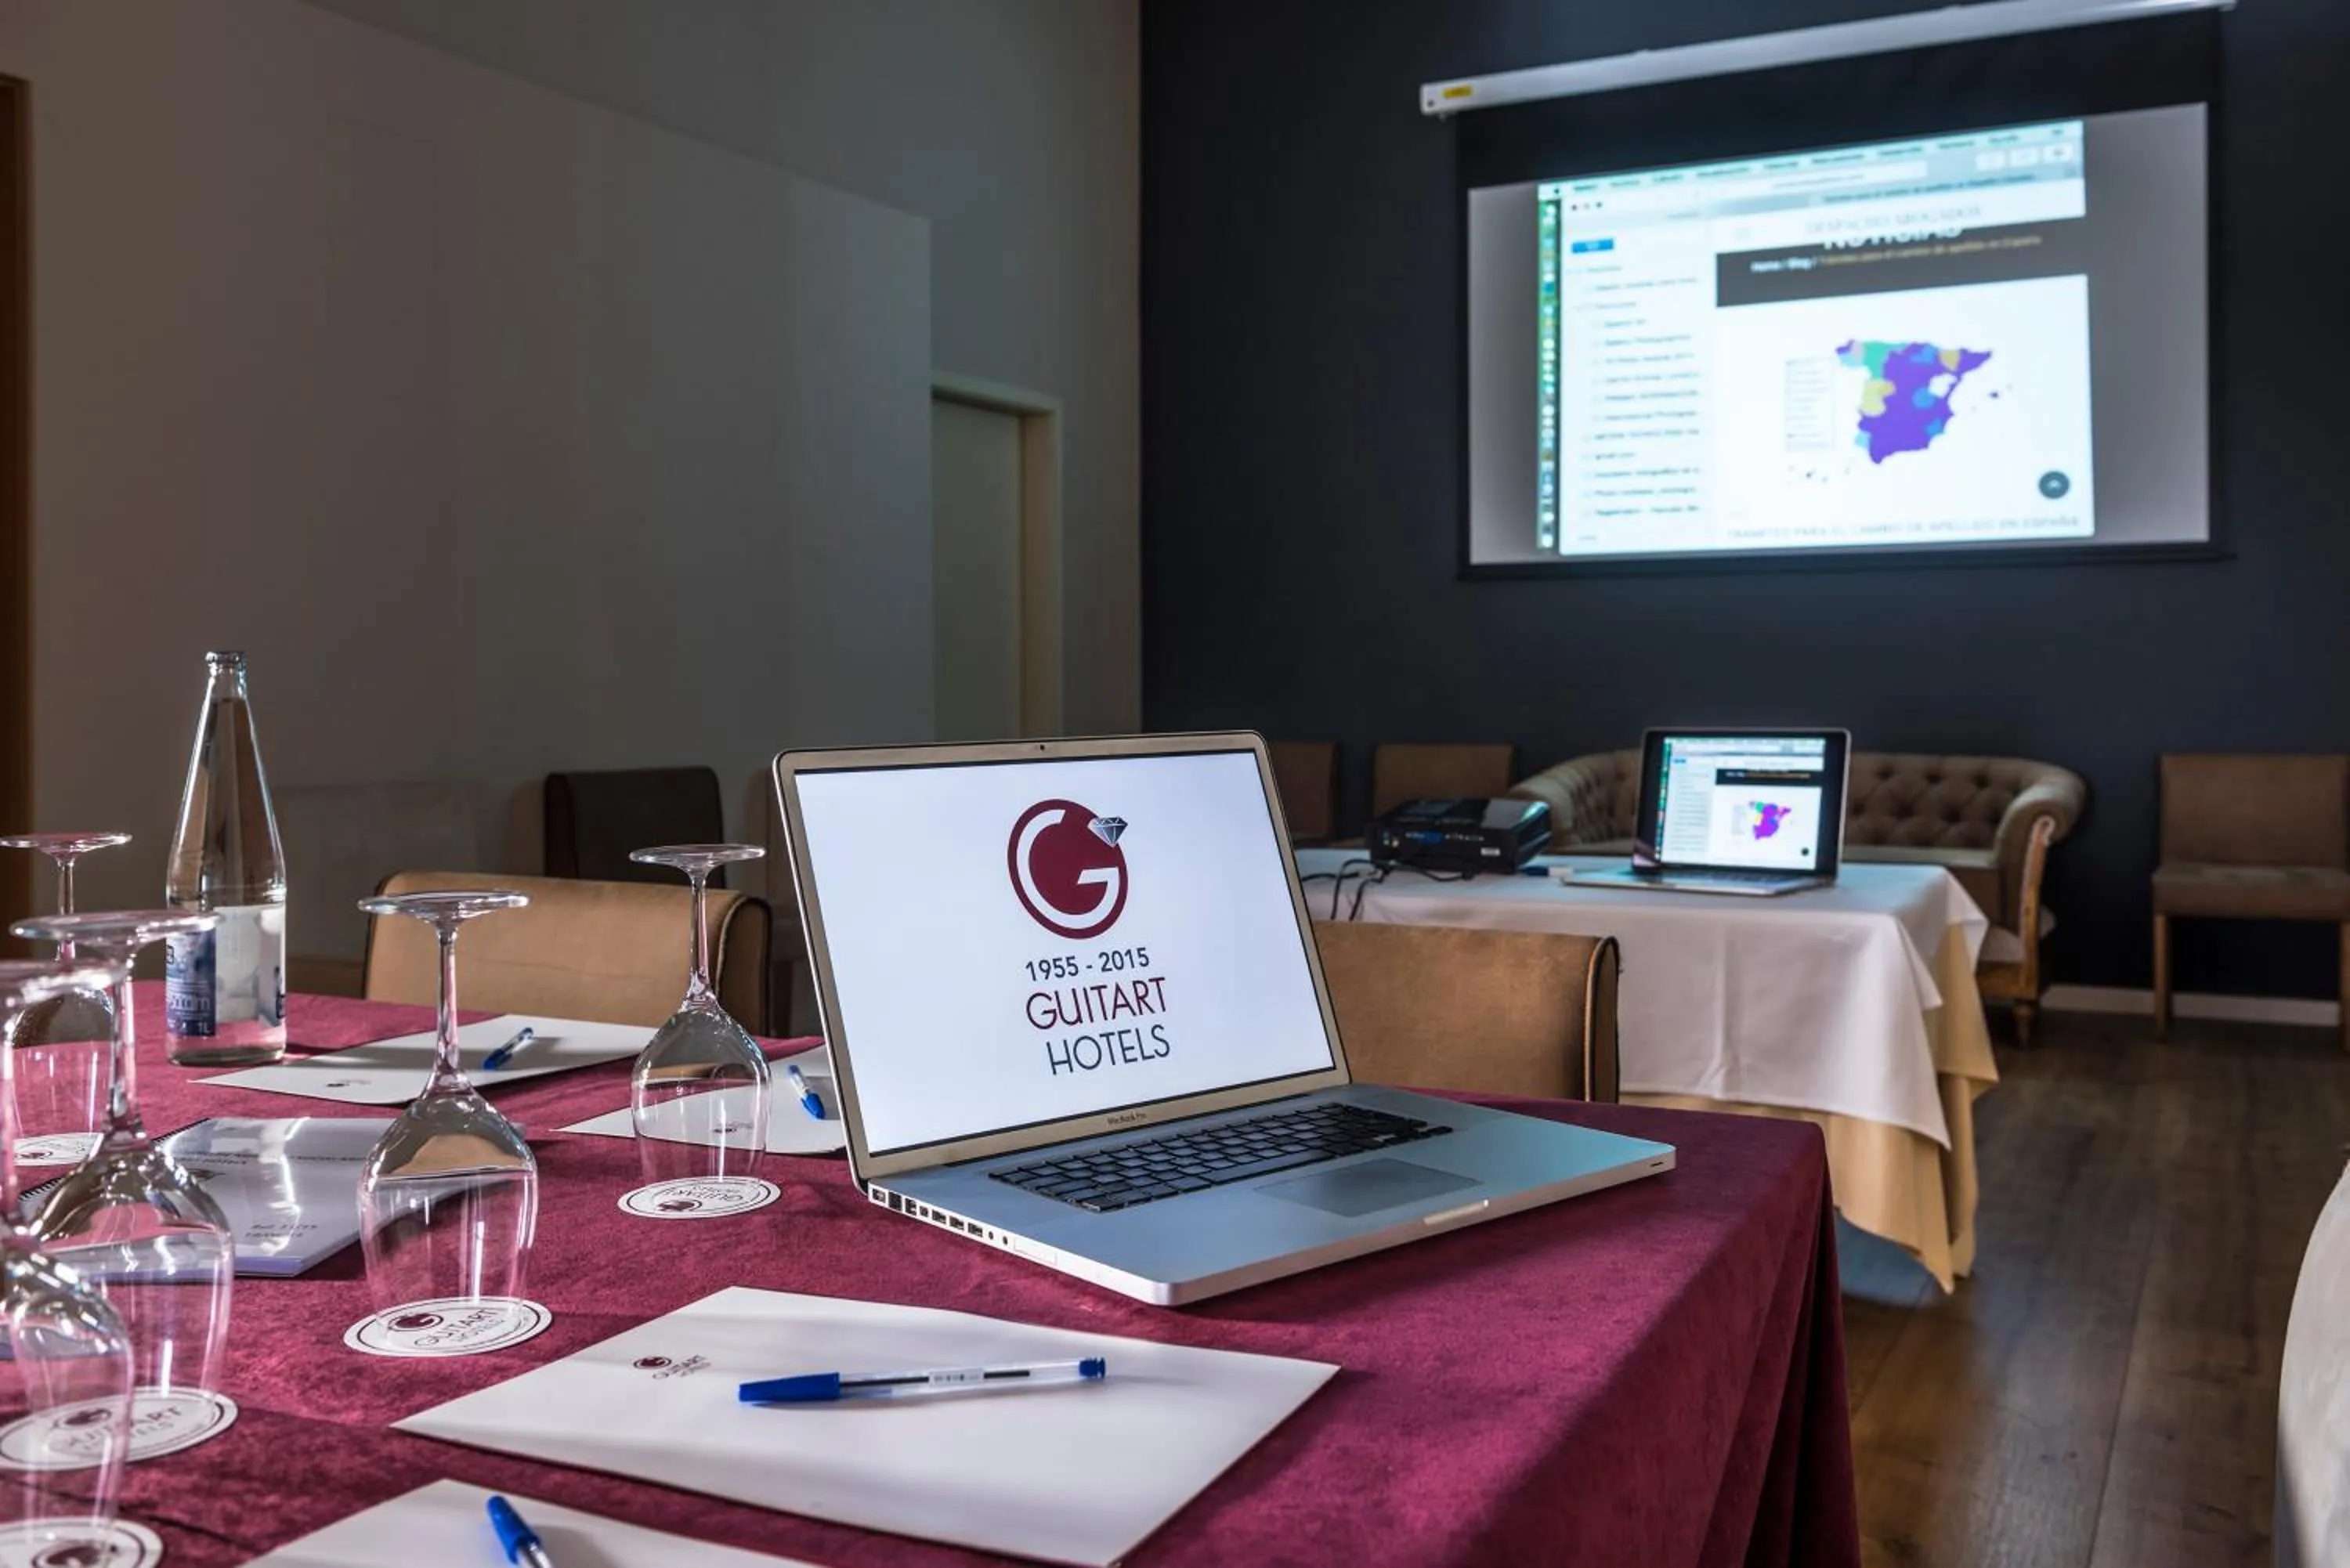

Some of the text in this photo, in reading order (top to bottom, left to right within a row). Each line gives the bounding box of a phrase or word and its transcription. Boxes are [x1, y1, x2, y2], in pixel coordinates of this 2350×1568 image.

[1025, 955, 1079, 981] 1955
[1098, 947, 1151, 974] 2015
[1025, 976, 1167, 1030] GUITART
[1046, 1024, 1171, 1075] HOTELS
